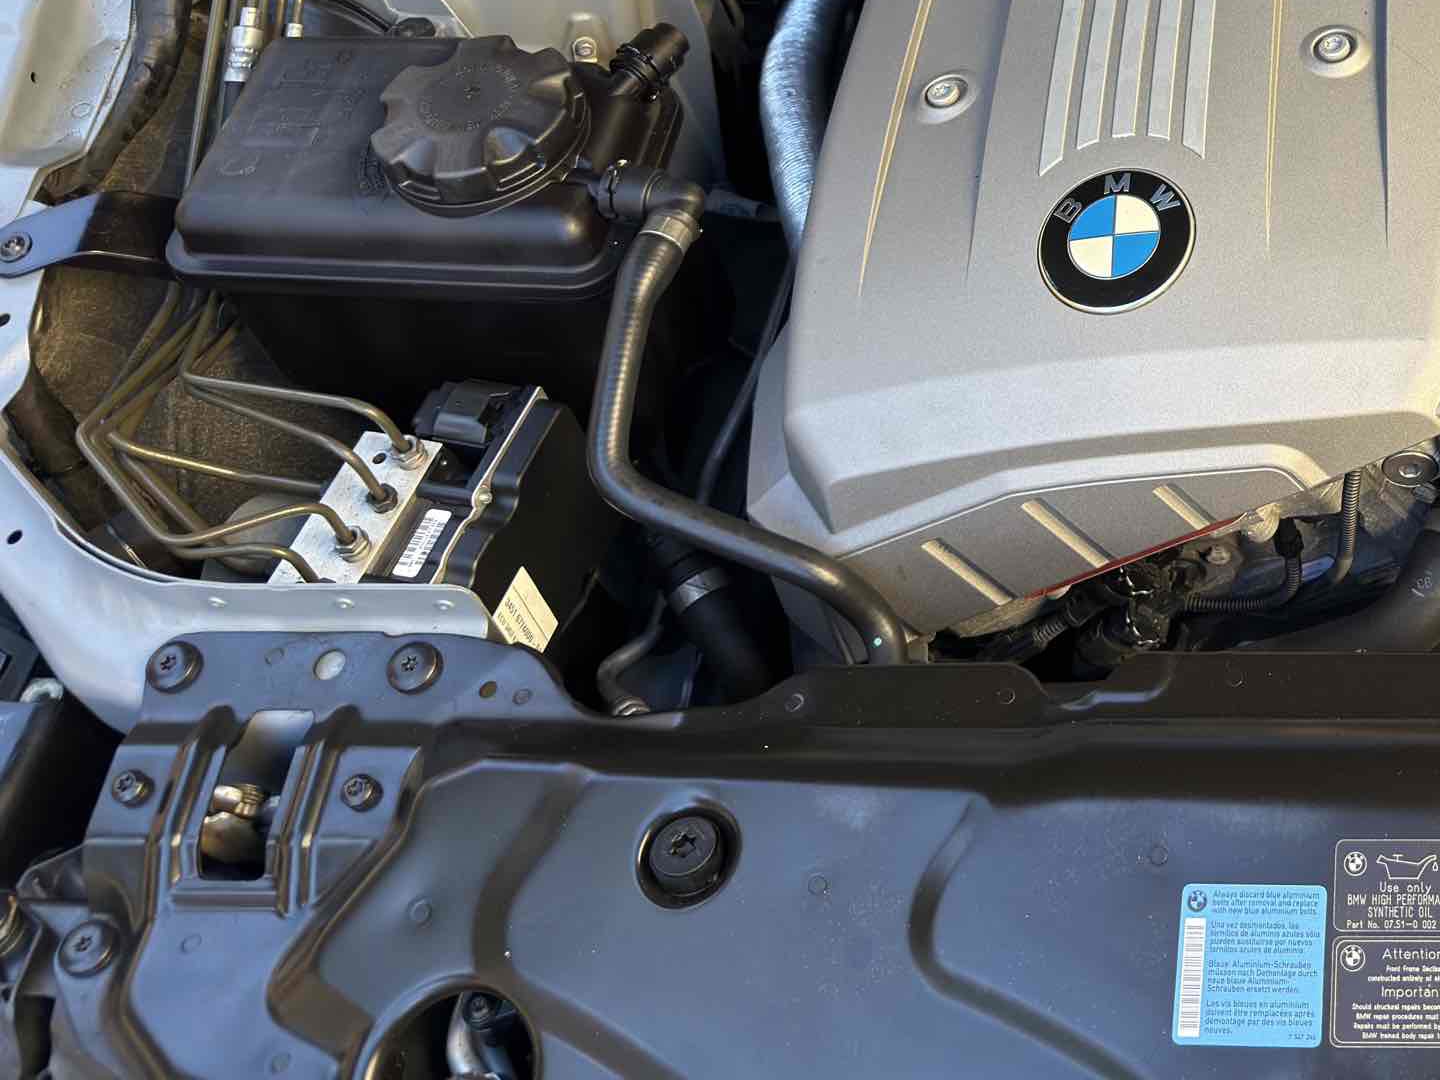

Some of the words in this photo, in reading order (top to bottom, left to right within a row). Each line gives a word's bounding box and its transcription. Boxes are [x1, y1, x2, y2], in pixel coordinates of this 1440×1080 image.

[1053, 172, 1181, 223] BMW
[1380, 882, 1398, 892] Use
[1407, 882, 1431, 895] only
[1348, 894, 1366, 905] BMW
[1372, 895, 1392, 905] HIGH
[1368, 907, 1414, 918] SYNTHETIC
[1419, 907, 1432, 918] OIL
[1347, 920, 1363, 929] Part
[1368, 920, 1380, 929] No.
